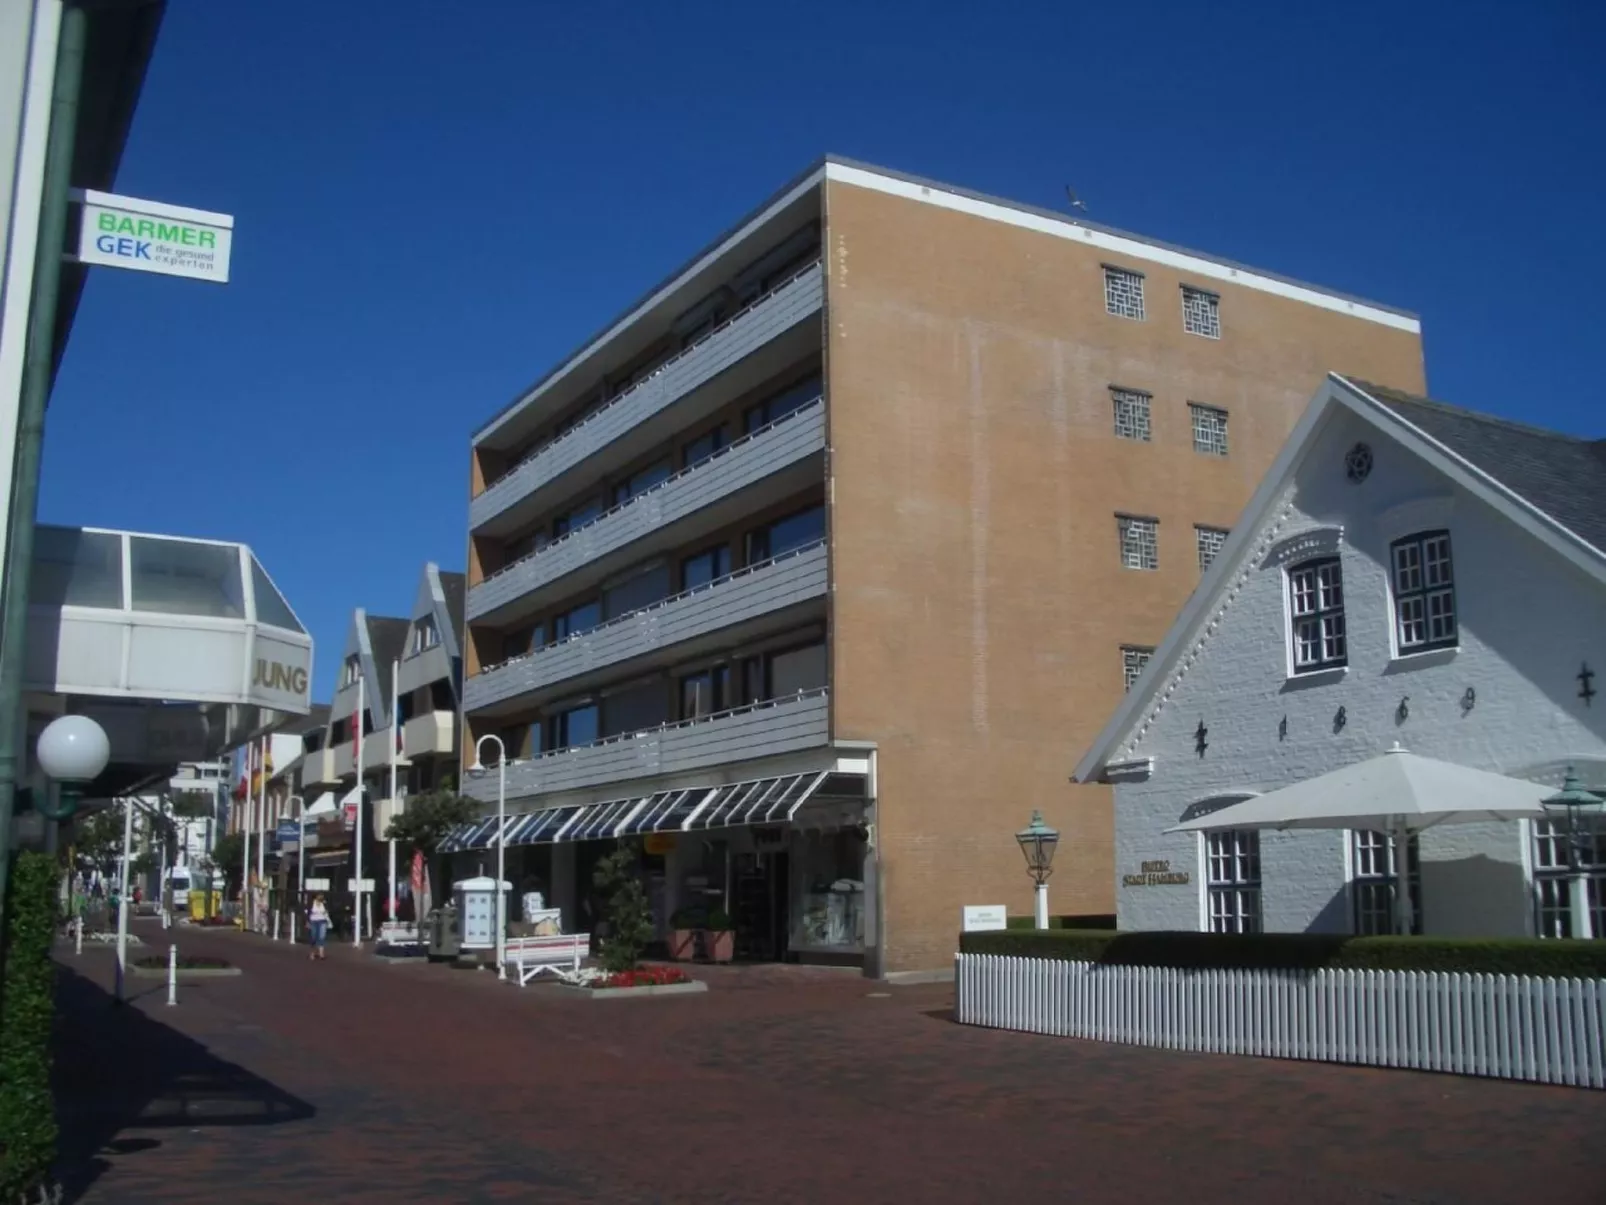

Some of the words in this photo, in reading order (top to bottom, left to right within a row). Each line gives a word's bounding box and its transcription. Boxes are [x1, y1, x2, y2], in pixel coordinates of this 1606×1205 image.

[96, 235, 151, 261] GEK
[175, 249, 214, 262] gesund
[98, 212, 216, 249] BARMER
[253, 659, 307, 695] JUNG
